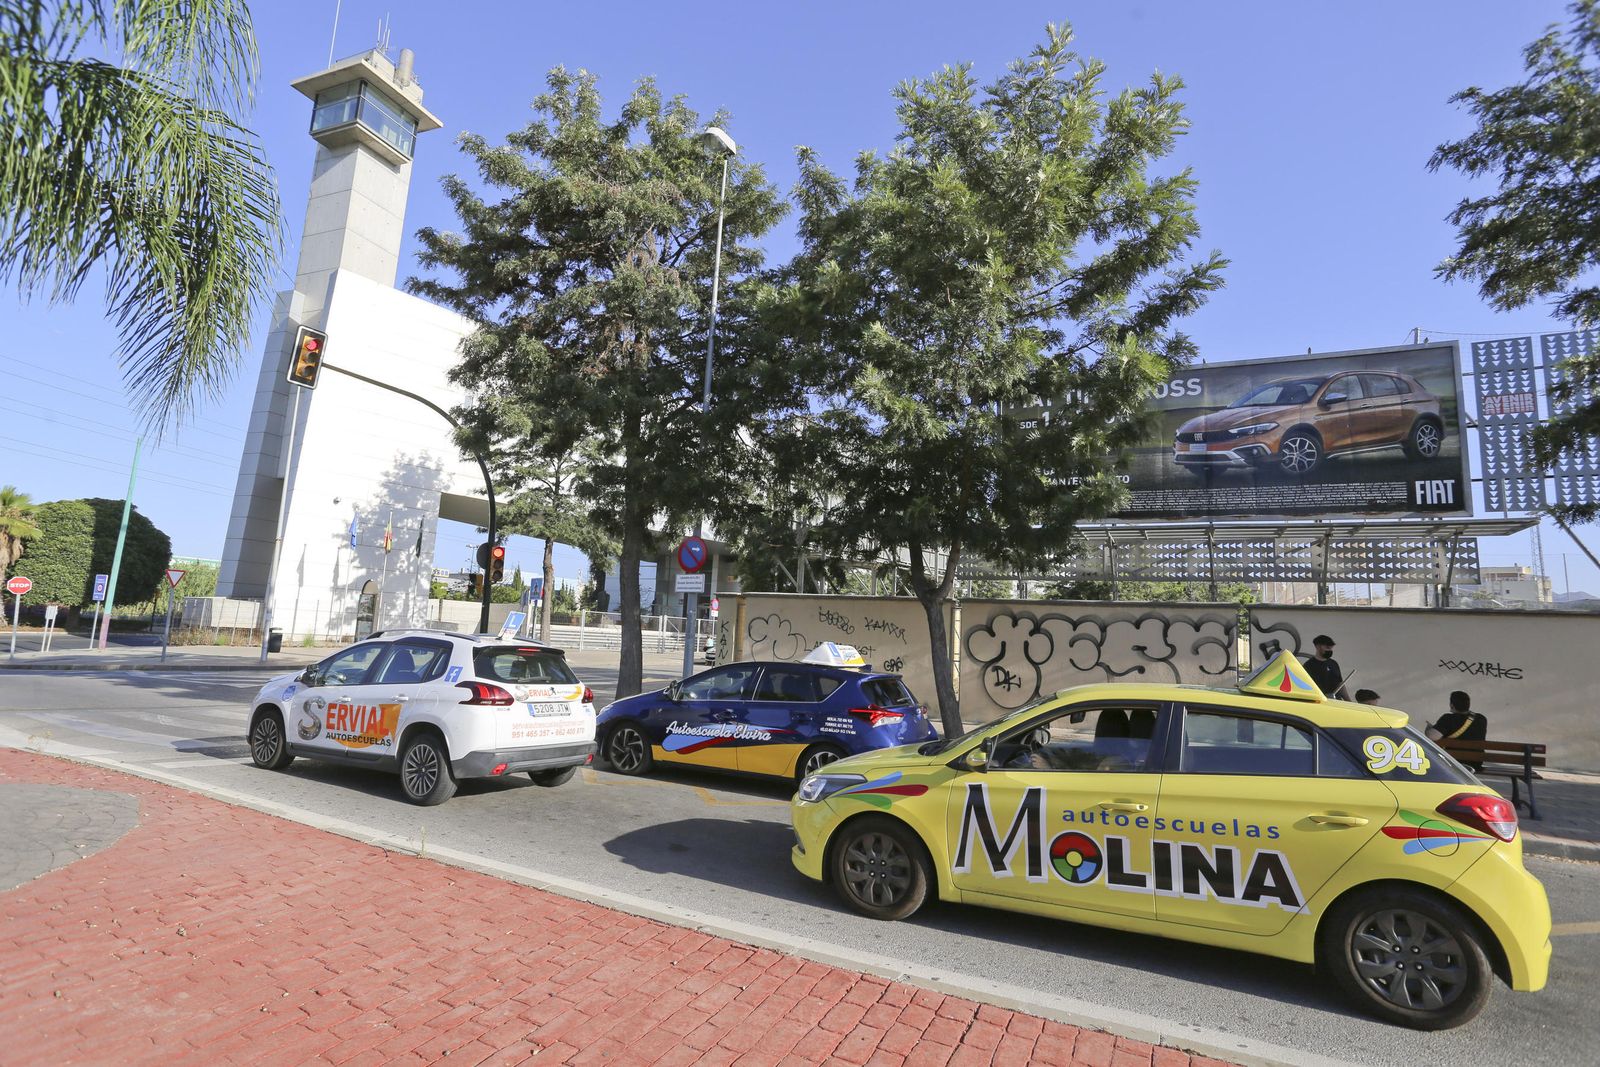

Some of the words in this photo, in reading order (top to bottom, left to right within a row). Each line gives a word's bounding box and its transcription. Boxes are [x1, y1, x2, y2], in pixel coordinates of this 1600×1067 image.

[1146, 378, 1202, 399] OSS
[1416, 479, 1456, 506] FIAT
[508, 615, 517, 628] L
[298, 696, 390, 740] SERVIAL
[534, 703, 555, 714] 5208
[326, 732, 392, 747] AUTOESCUELAS
[666, 720, 732, 738] Autoescuela
[733, 725, 772, 741] Elvira
[1364, 736, 1425, 772] 94
[1062, 808, 1281, 839] autoescuelas
[955, 783, 1309, 912] MOLINA
